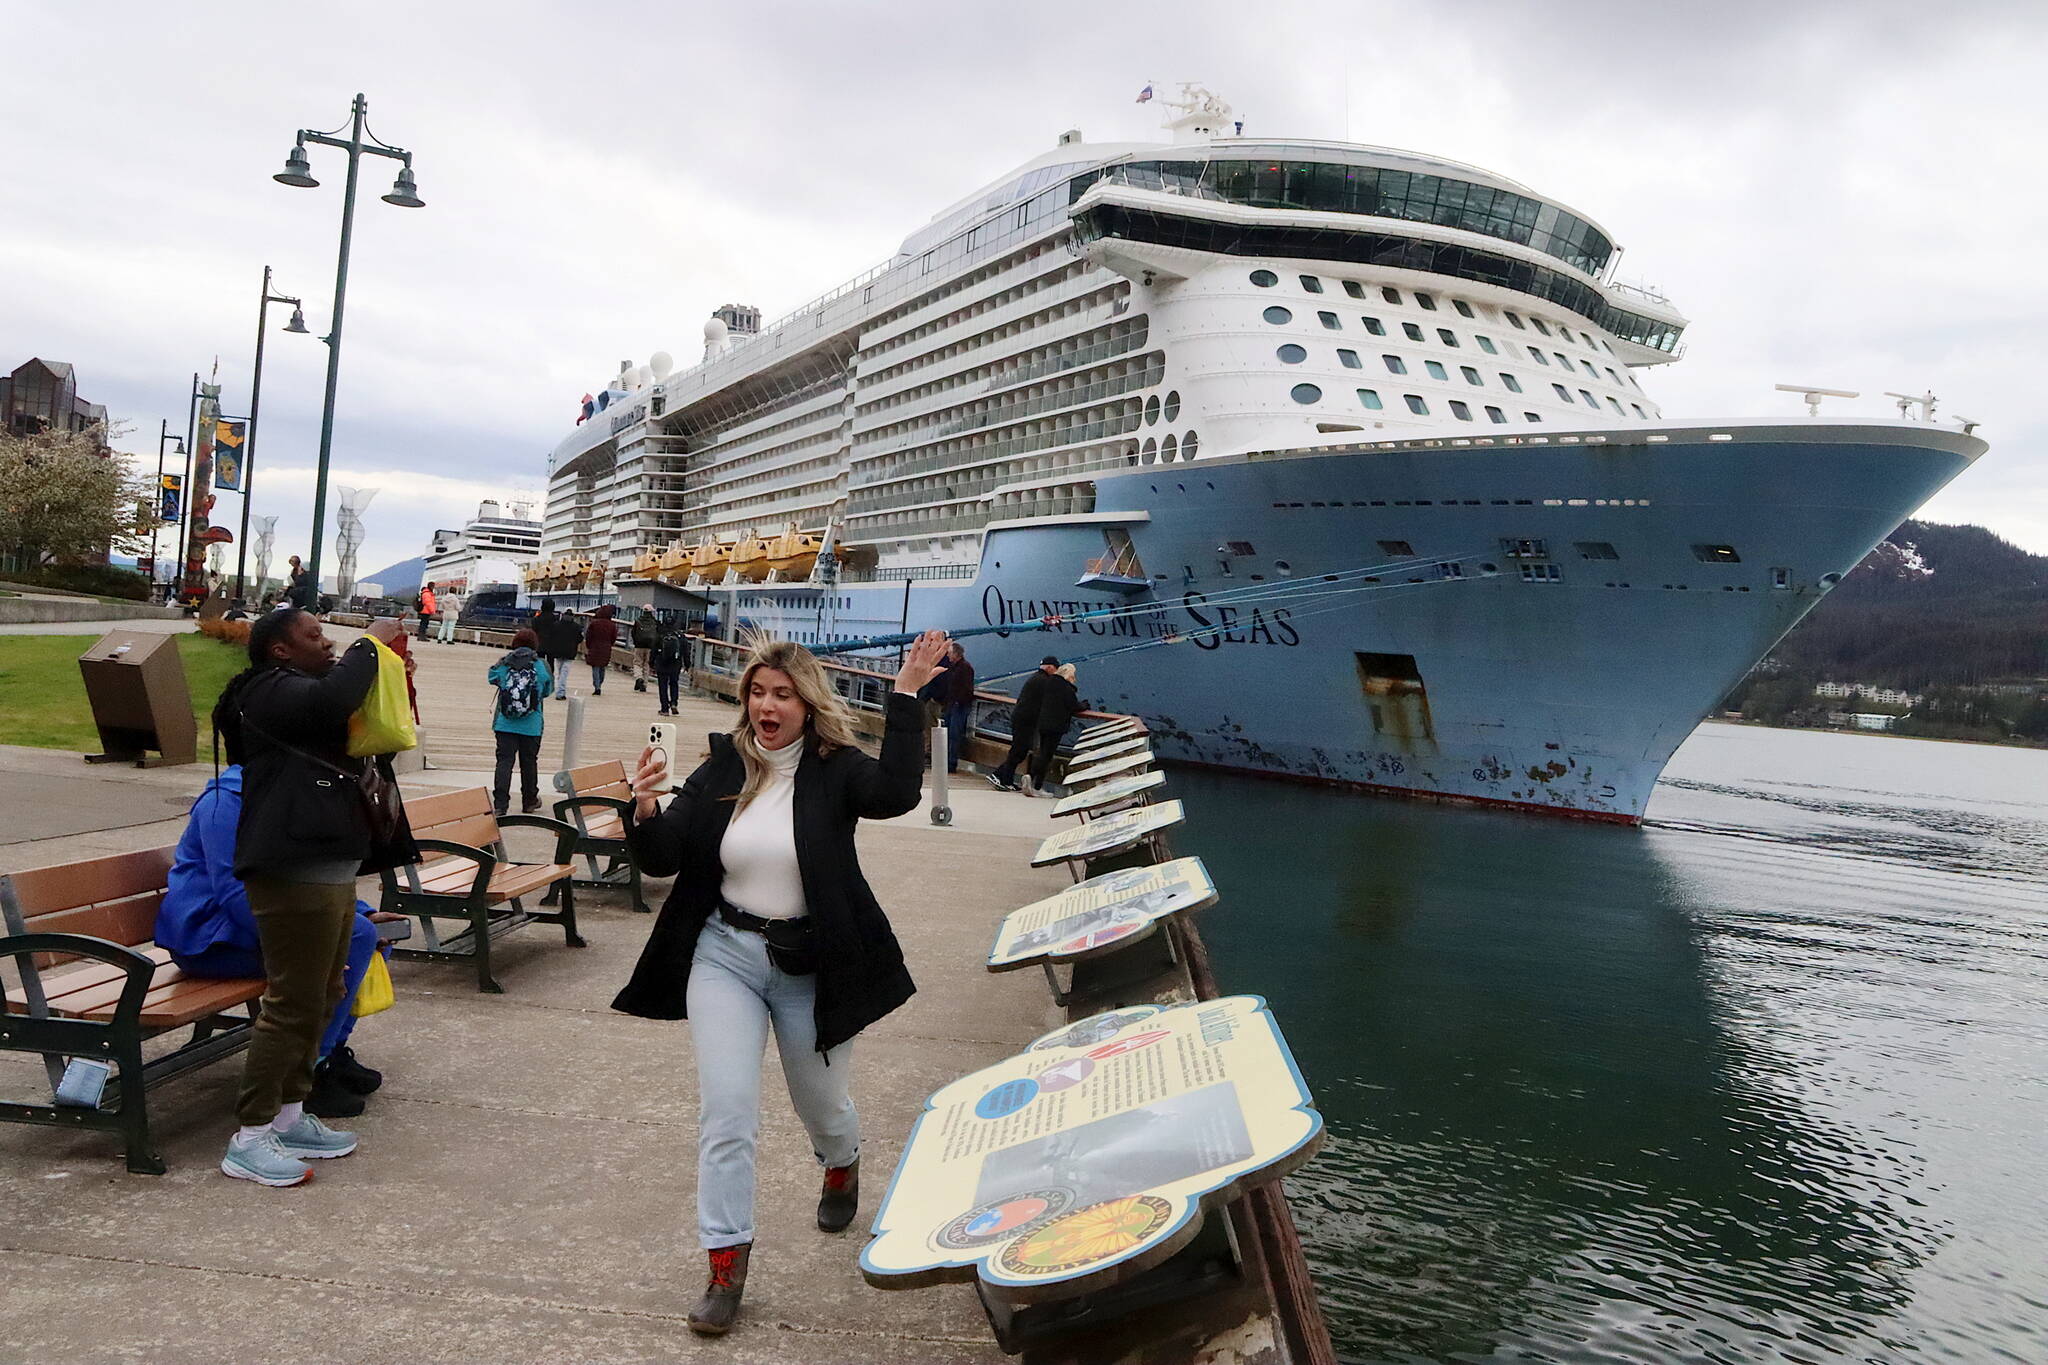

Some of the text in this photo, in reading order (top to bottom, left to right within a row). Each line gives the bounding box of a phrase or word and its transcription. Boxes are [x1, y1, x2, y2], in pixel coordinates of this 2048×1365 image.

[982, 585, 1300, 650] QUANTUM OF THE SEAS
